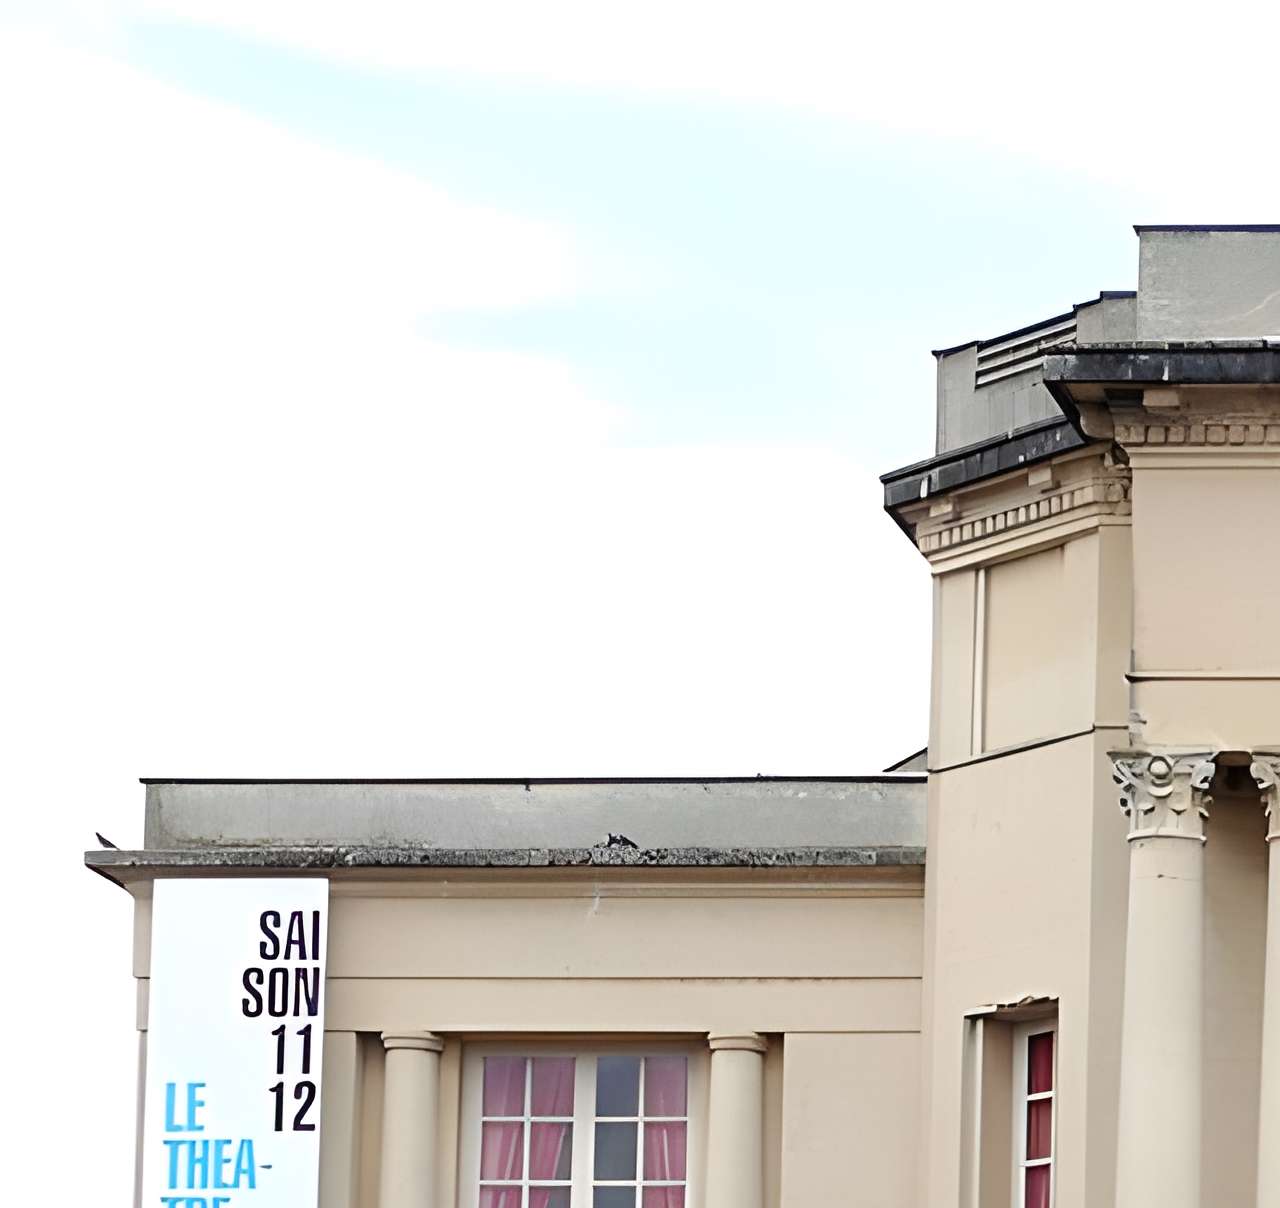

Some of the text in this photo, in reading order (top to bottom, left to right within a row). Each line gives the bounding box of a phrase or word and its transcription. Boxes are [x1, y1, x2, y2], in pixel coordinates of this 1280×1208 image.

[260, 910, 320, 960] SAI
[242, 967, 320, 1018] SON
[272, 1024, 312, 1075] 11
[165, 1082, 206, 1132] LE
[269, 1081, 316, 1132] 12
[163, 1139, 272, 1190] THEA-
